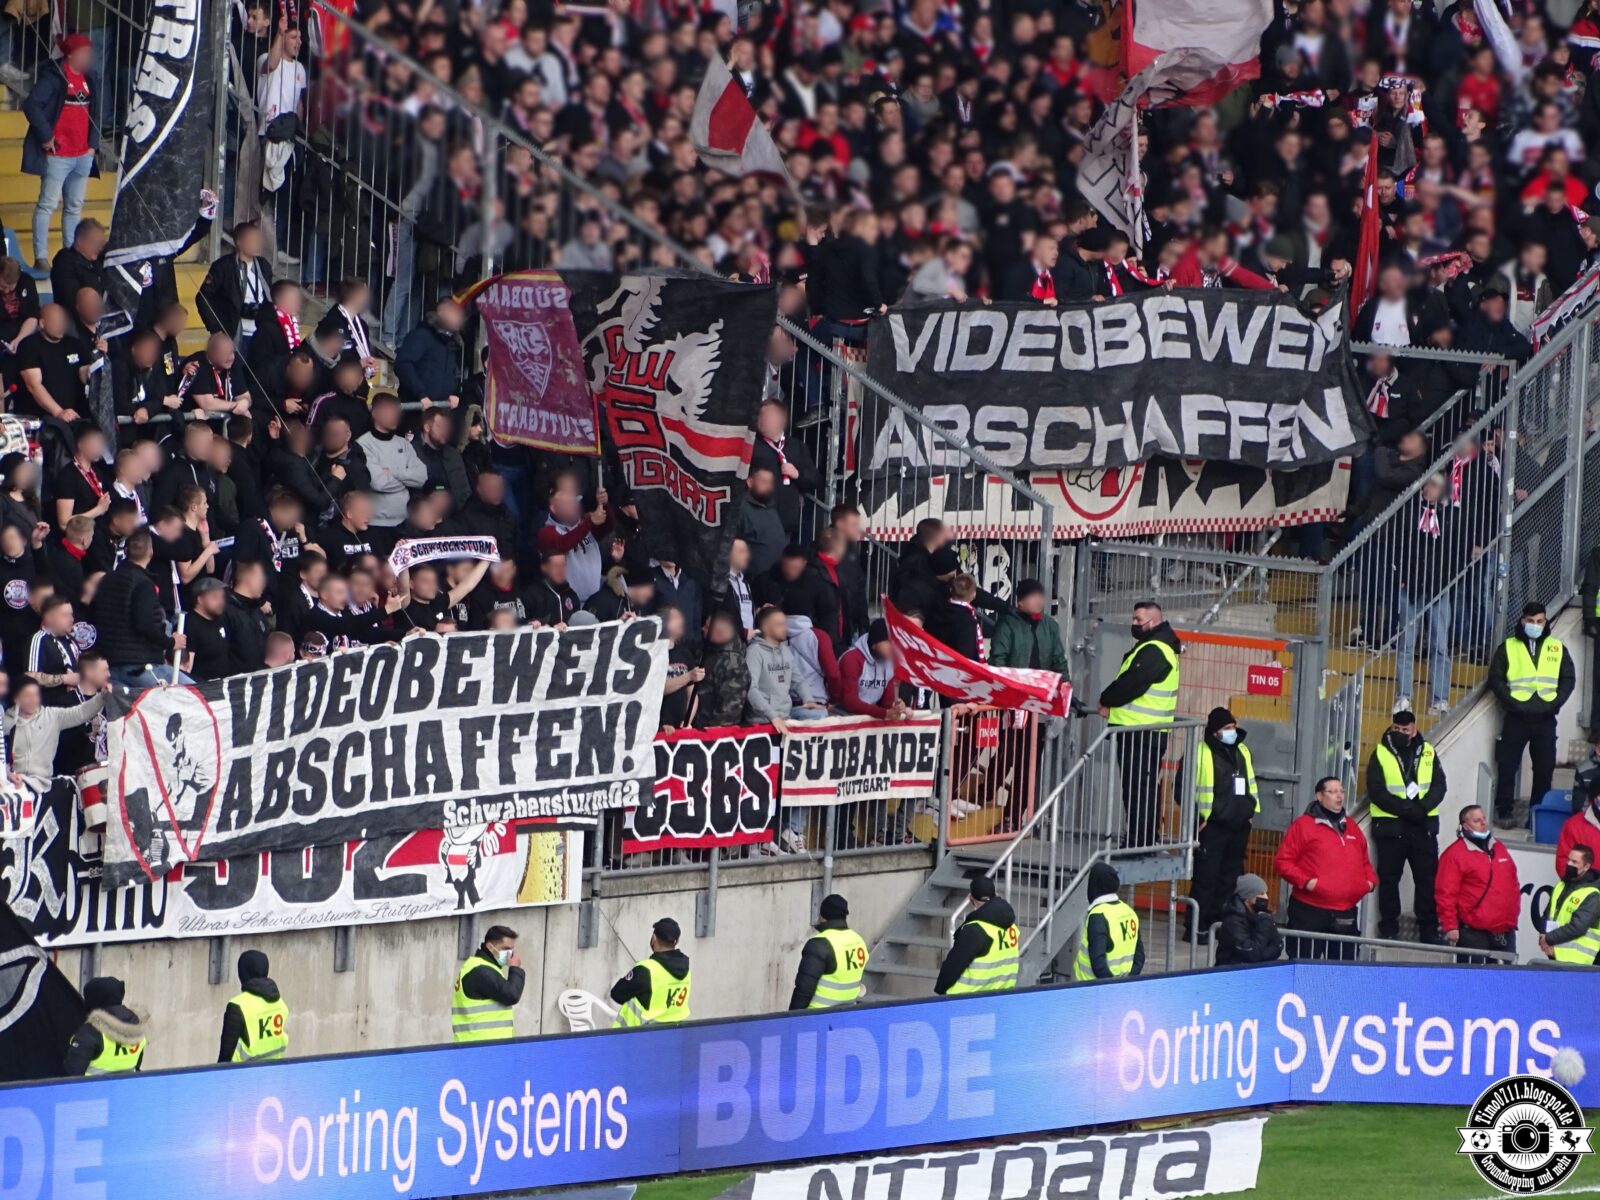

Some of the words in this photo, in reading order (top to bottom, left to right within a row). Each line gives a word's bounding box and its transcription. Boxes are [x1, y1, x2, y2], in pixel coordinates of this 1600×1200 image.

[868, 386, 1357, 471] ABSCHAFFEN
[1547, 645, 1560, 653] K9
[226, 618, 659, 748] VIDEOBEWEIS
[1250, 674, 1266, 685] TIN
[1268, 676, 1279, 687] 05
[216, 700, 643, 832] ABSCHAFFEN!
[784, 733, 936, 781] SÜDBANDE
[836, 777, 890, 797] STUTTGART
[178, 915, 230, 933] Ultras
[232, 909, 361, 929] Schwabensturm
[362, 899, 446, 921] Stuttgart
[1120, 919, 1137, 942] K9
[998, 927, 1018, 951] K9
[845, 947, 866, 971] K9
[666, 986, 688, 1009] K9
[258, 1014, 284, 1039] K9
[1119, 1003, 1259, 1099] Sorting
[1274, 993, 1562, 1093] Systems
[696, 1013, 996, 1149] BUDDE
[253, 1089, 418, 1193] Sorting
[437, 1078, 628, 1186] Systems
[805, 1153, 979, 1200] NTT
